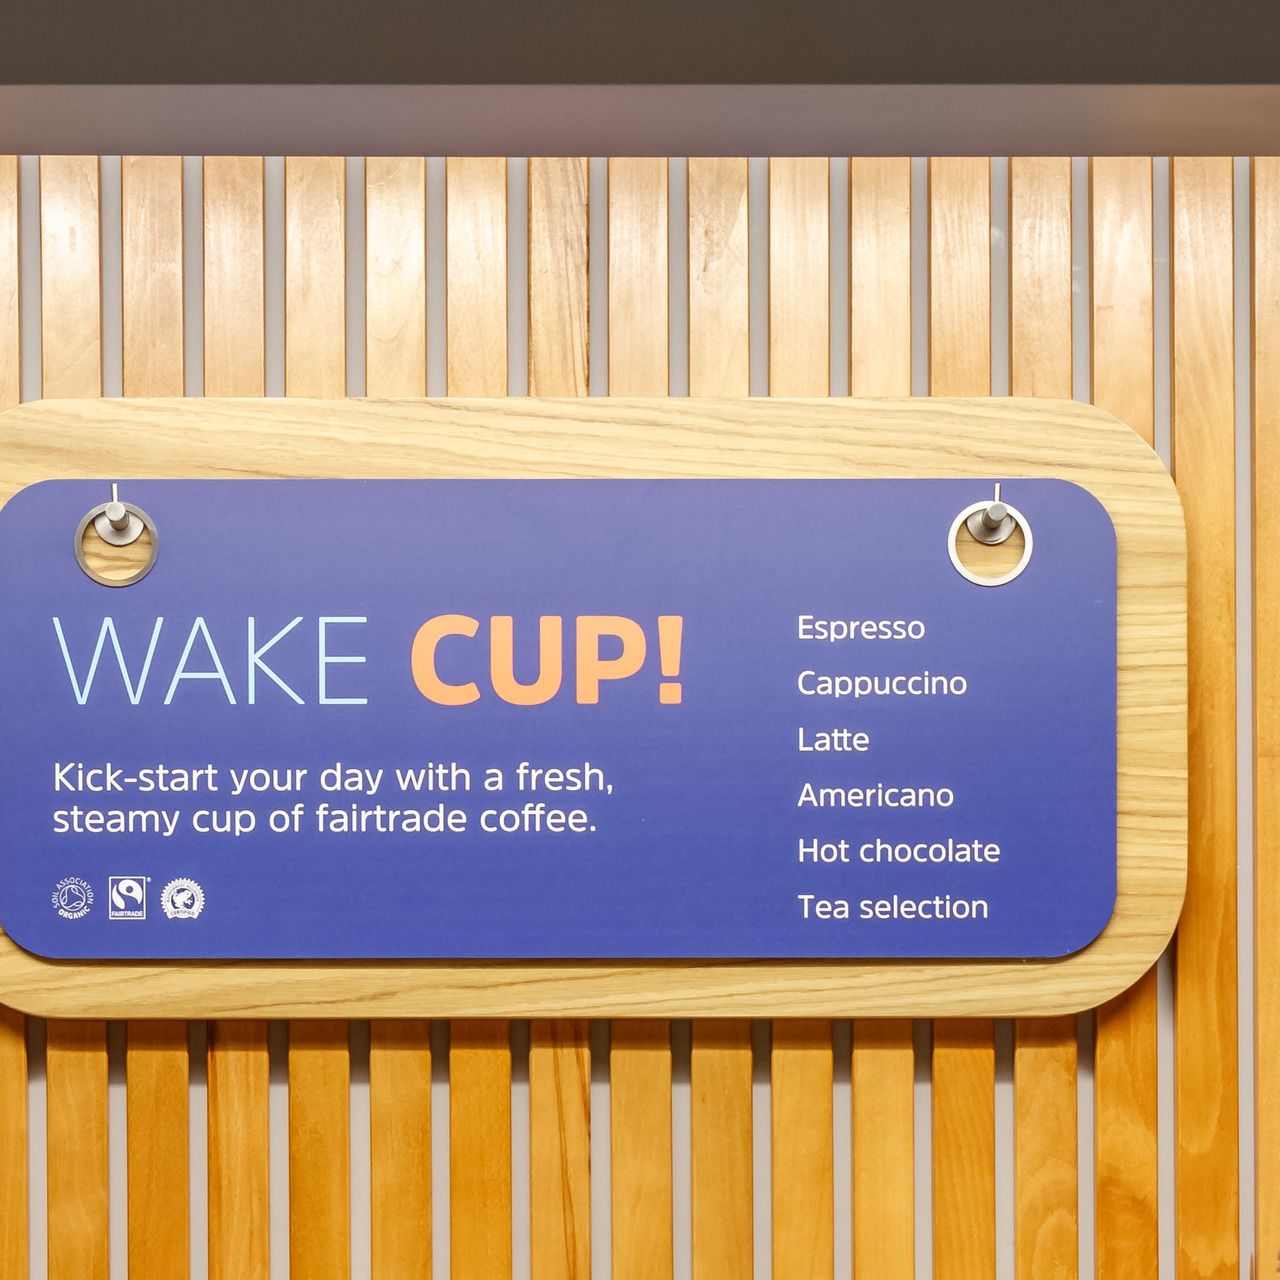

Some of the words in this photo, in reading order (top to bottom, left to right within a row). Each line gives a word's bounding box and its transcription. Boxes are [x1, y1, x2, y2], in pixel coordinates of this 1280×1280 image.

[798, 614, 926, 643] Espresso
[53, 616, 368, 705] WAKE
[411, 613, 684, 706] CUP!
[797, 670, 968, 699] Cappuccino
[798, 726, 870, 752] Latte
[54, 762, 219, 792] Kick-start
[229, 768, 308, 796] your
[320, 762, 384, 796] day
[395, 761, 471, 792] with
[483, 768, 503, 791] a
[515, 761, 613, 796] fresh,
[797, 782, 954, 808] Americano
[53, 805, 180, 837] steamy
[192, 809, 256, 837] cup
[269, 802, 305, 833] of
[315, 802, 467, 833] fairtrade
[479, 801, 596, 833] coffee.
[798, 838, 850, 864] Hot
[859, 838, 1001, 864] chocolate
[58, 905, 91, 920] ORGANIC
[797, 894, 849, 920] Tea
[859, 894, 989, 919] selection
